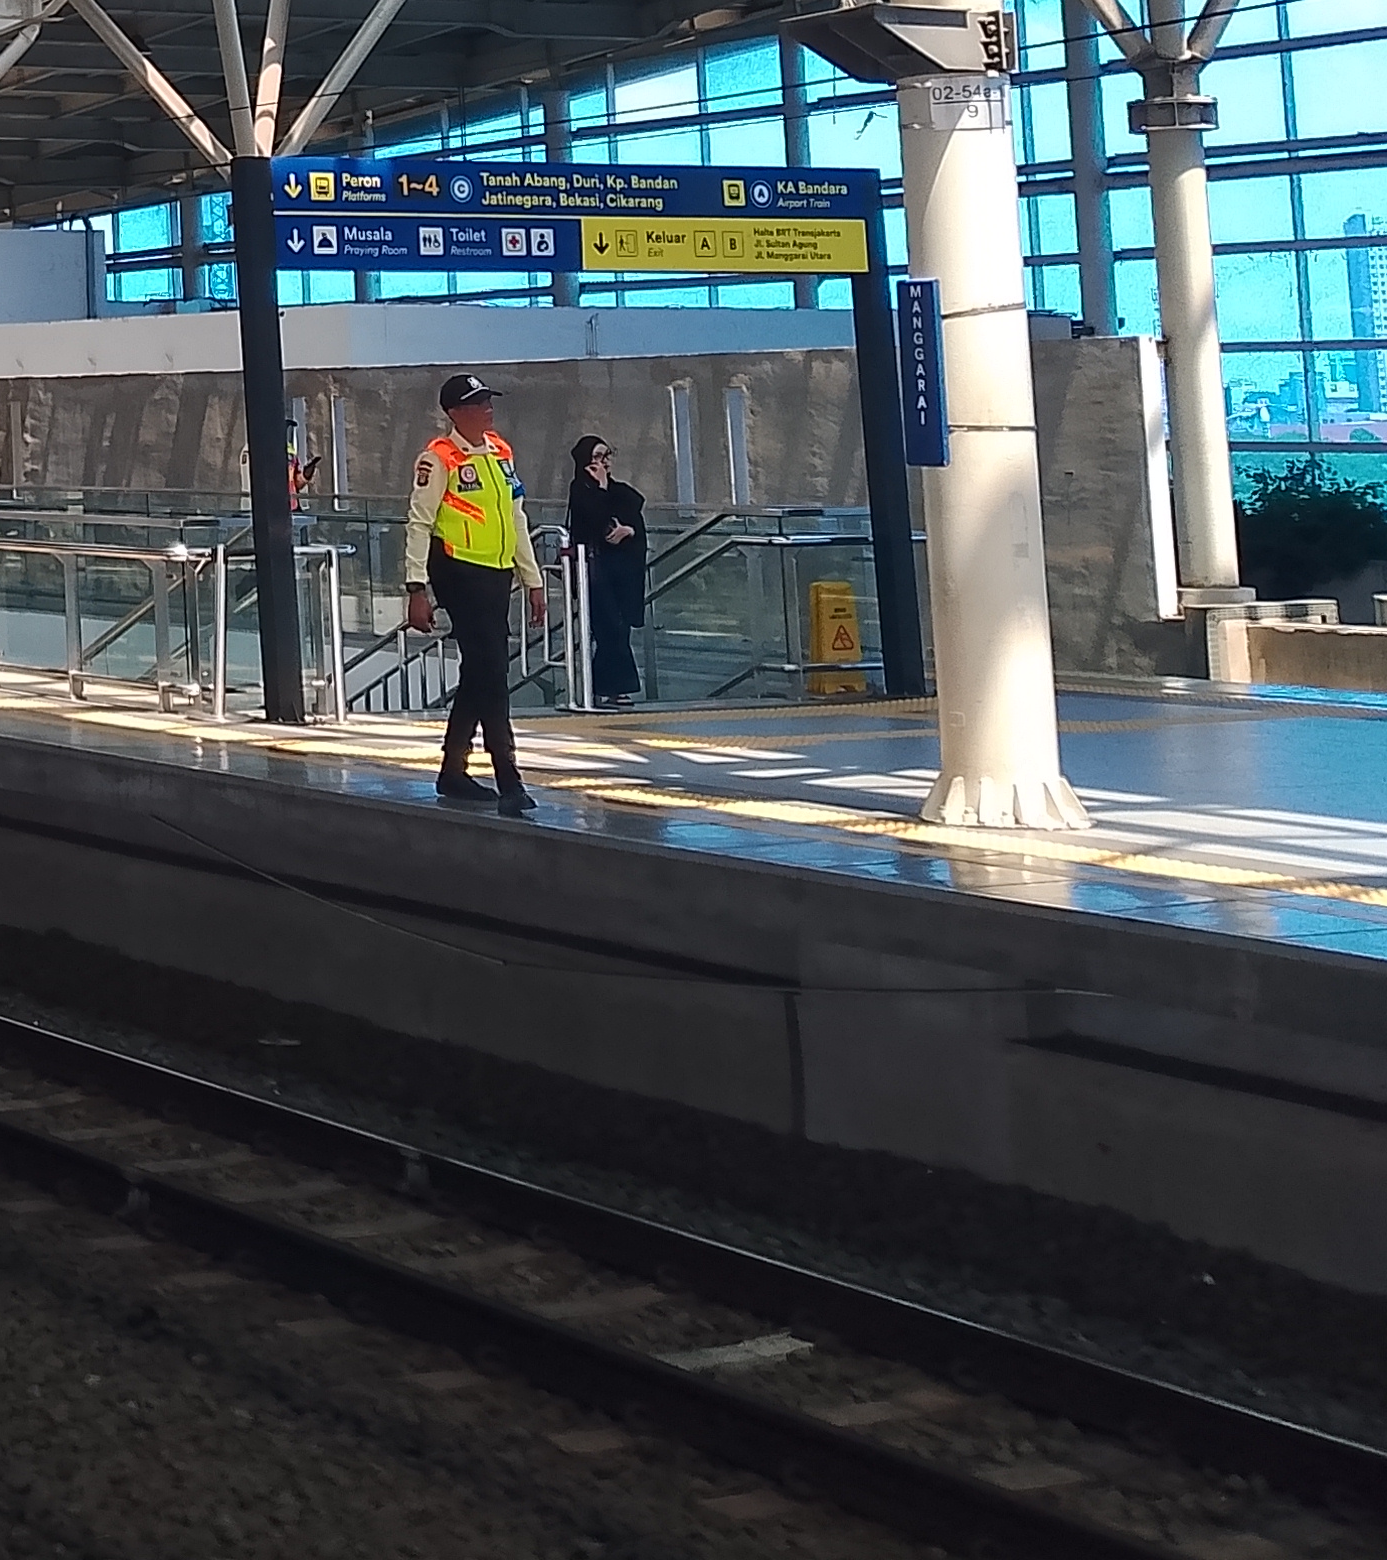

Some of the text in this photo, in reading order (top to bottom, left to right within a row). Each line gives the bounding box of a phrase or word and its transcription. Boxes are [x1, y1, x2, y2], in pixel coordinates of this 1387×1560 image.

[967, 105, 978, 118] 9
[342, 173, 381, 188] Peron
[398, 174, 440, 197] 1~4
[480, 172, 678, 191] Tanah Abang, Duri, Kp. Bandan
[777, 181, 848, 196] KA Bandara
[342, 192, 386, 202] Platforms
[481, 191, 663, 211] Jatinegara, Bekasi, Cikarang
[776, 197, 831, 209] Airport Train
[344, 227, 392, 241] Musala
[449, 228, 487, 242] Toilet
[646, 231, 686, 244] Keluar
[700, 238, 710, 250] A
[729, 238, 737, 250] B
[792, 241, 818, 251] Agung
[344, 245, 408, 257] Praying Room
[450, 246, 492, 256] Restroom
[648, 247, 664, 258] Exit
[810, 252, 831, 260] Utara
[909, 285, 928, 425] MANGGARAI
